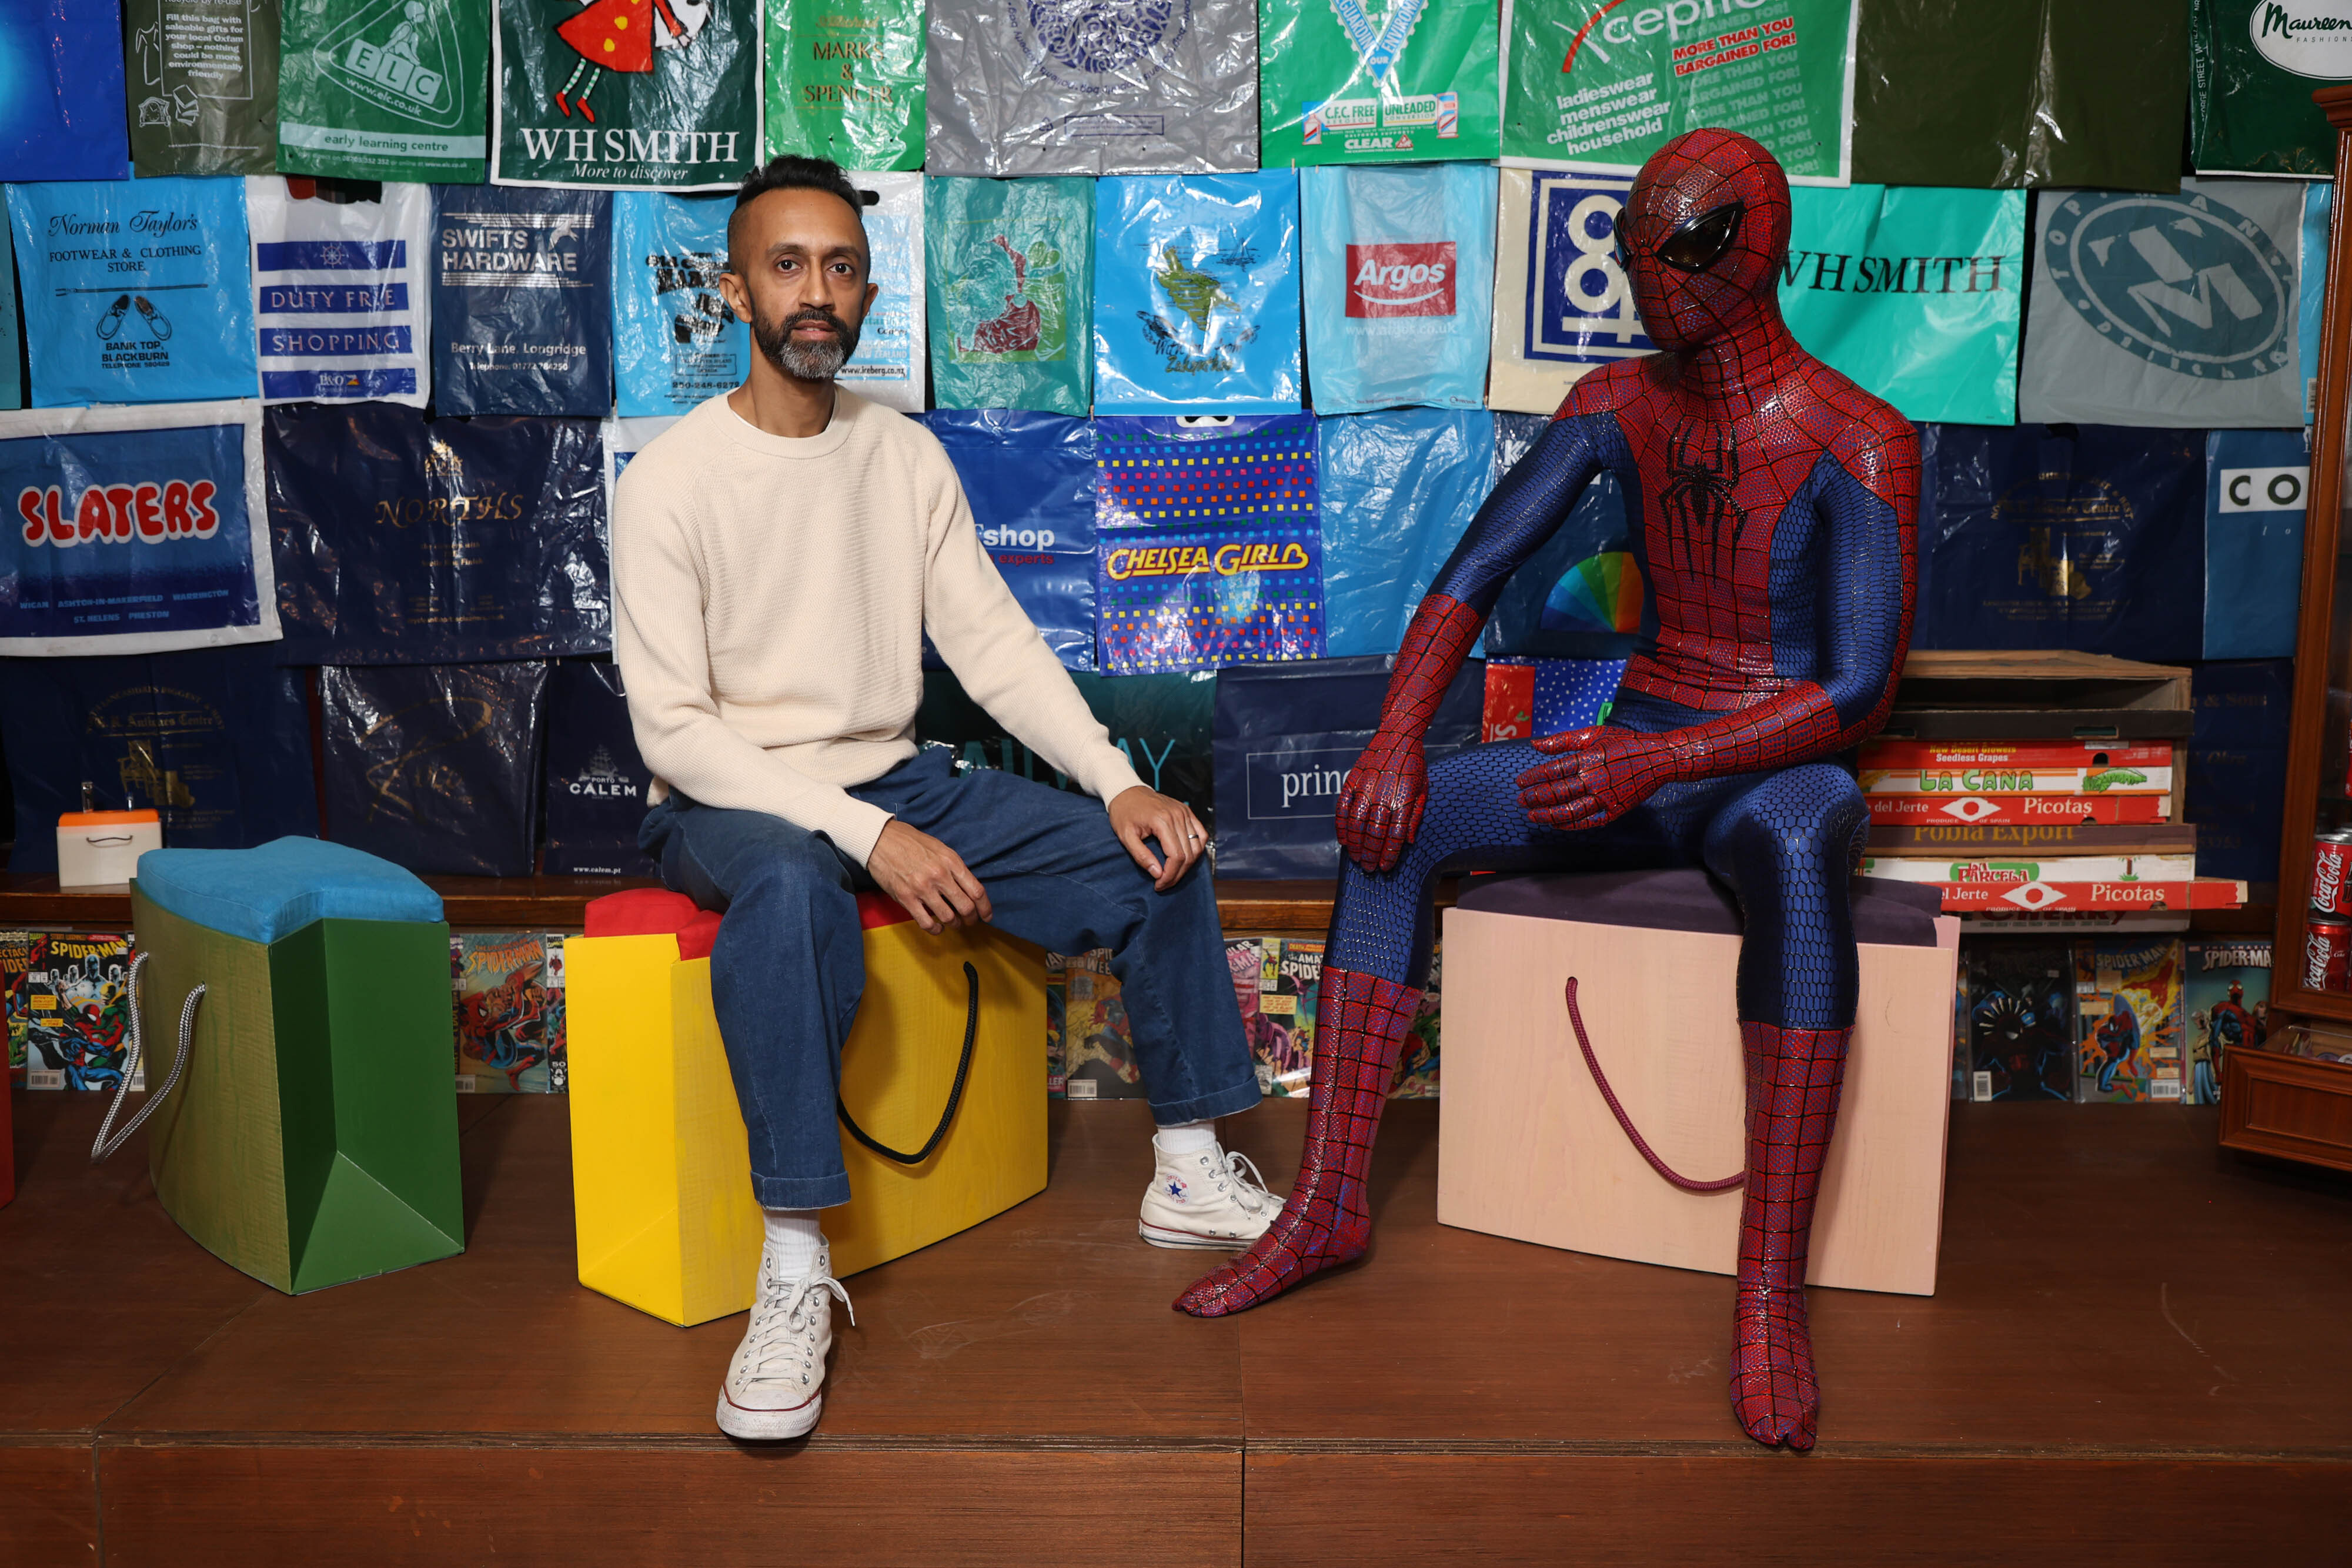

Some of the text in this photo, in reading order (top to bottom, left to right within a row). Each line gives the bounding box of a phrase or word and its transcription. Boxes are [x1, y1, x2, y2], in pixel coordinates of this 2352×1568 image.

[165, 24, 205, 32] saleable
[206, 25, 229, 34] gifts
[202, 15, 220, 24] bag
[2261, 2, 2352, 39] Maureen
[171, 42, 240, 54] shop nothing
[213, 35, 244, 43] Oxfam
[1672, 16, 1794, 62] MORE THAN YOU
[813, 41, 884, 61] MARKS
[1369, 56, 1389, 65] OUR
[1674, 32, 1798, 78] BARGAINED FOR!
[168, 61, 243, 72] environmentally
[188, 69, 224, 80] friendly
[840, 63, 854, 81] &
[346, 76, 423, 117] www.elc.co.uk
[804, 84, 894, 103] SPENCER
[1556, 72, 1654, 110] ladieswear
[1352, 105, 1375, 118] FREE
[1385, 101, 1436, 116] UNLEADED
[1560, 88, 1658, 125] menswear
[1546, 101, 1671, 146] childrenswear
[325, 135, 449, 152] early learning centre
[520, 128, 740, 164] WH SMITH
[1344, 138, 1394, 149] CLEAR
[1567, 117, 1663, 156] household
[572, 163, 689, 180] More to discover
[48, 210, 198, 238] Norman Taylor's
[442, 229, 529, 249] SWIFTS
[49, 245, 202, 262] FOOTWEAR & CLOTHING
[442, 252, 577, 272] HARDWARE
[107, 261, 146, 273] STORE
[1354, 259, 1446, 292] Argos
[1853, 255, 2006, 294] SMITH
[271, 289, 395, 308] DUTY FRE
[1346, 321, 1458, 337] www.argos.co.uk
[106, 342, 136, 351] BANK
[272, 332, 399, 352] SHOPPING
[451, 342, 484, 356] Berry
[523, 343, 587, 358] Longridge
[101, 352, 169, 362] BLACKBURN
[18, 479, 220, 548] SLATERS
[375, 491, 524, 529] NORTHS
[998, 553, 1055, 567] experts
[1107, 543, 1297, 580] CHELSEA GIRL
[20, 601, 49, 610] WIGAN
[172, 589, 229, 601] WARRINGTON
[87, 613, 121, 623] HELENS
[128, 610, 169, 620] PRESTON
[1936, 753, 2009, 764] Seedless Grapes
[1919, 769, 1953, 791] LA
[1875, 797, 2093, 814] del Jerte Picotas
[573, 865, 622, 875] www.calem.pt
[2313, 848, 2343, 914] Coca-Cola
[1952, 887, 1989, 900] Jerte
[2090, 884, 2165, 902] Picotas
[49, 938, 128, 960] SPIDER-MAN
[466, 939, 546, 975] SPIDER-MAN
[2201, 950, 2273, 972] SPIDER-MA
